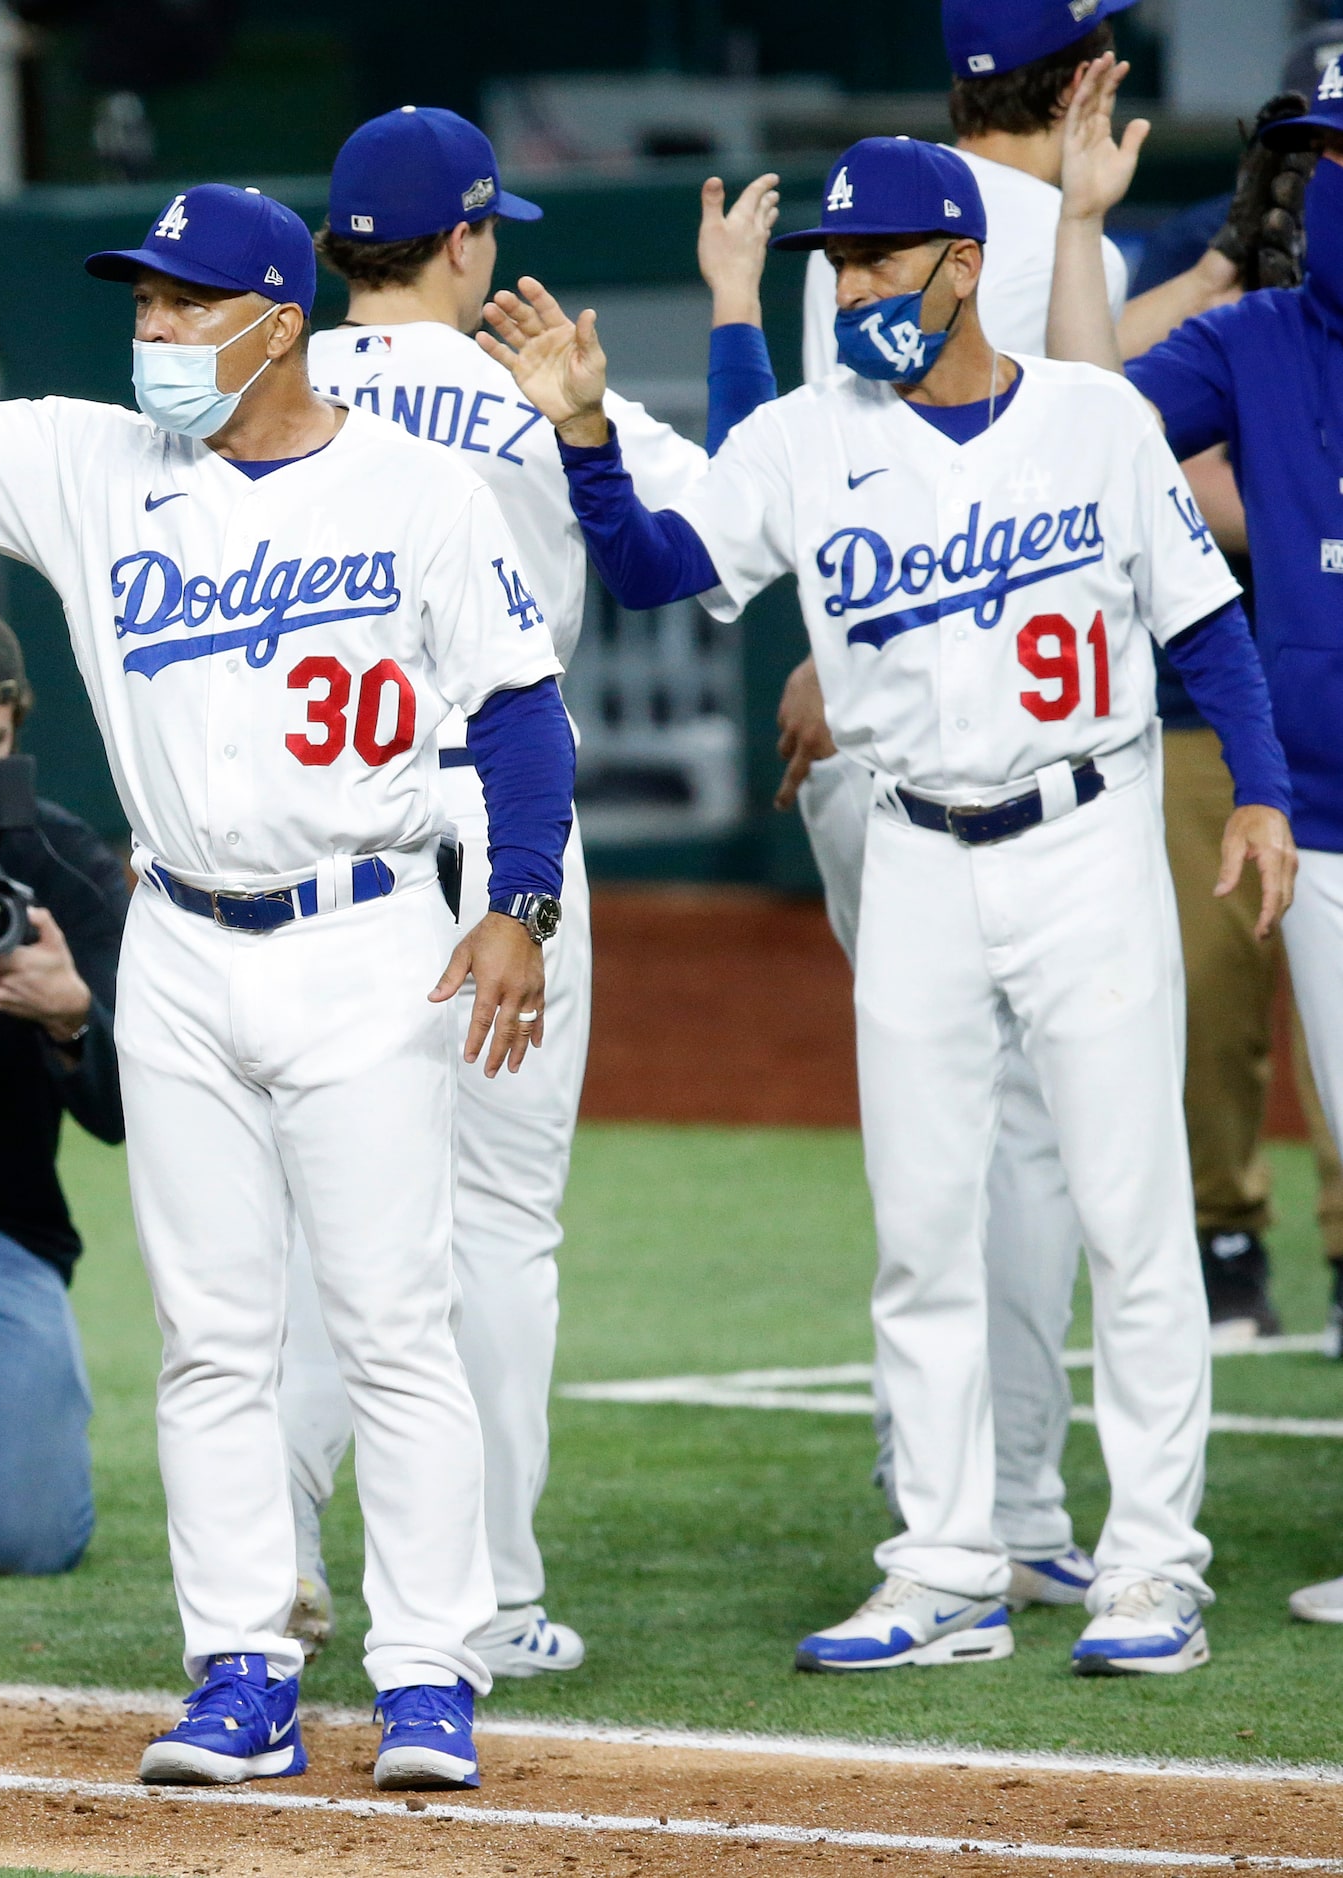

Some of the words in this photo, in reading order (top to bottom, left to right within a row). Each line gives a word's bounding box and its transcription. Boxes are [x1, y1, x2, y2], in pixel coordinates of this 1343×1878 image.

[155, 195, 188, 240] LA
[859, 312, 926, 373] LA
[312, 372, 545, 466] ÁNDEZ
[111, 540, 400, 669] Dodgers
[817, 501, 1104, 632] Dodgers
[285, 656, 416, 766] 30
[1017, 610, 1110, 722] 91
